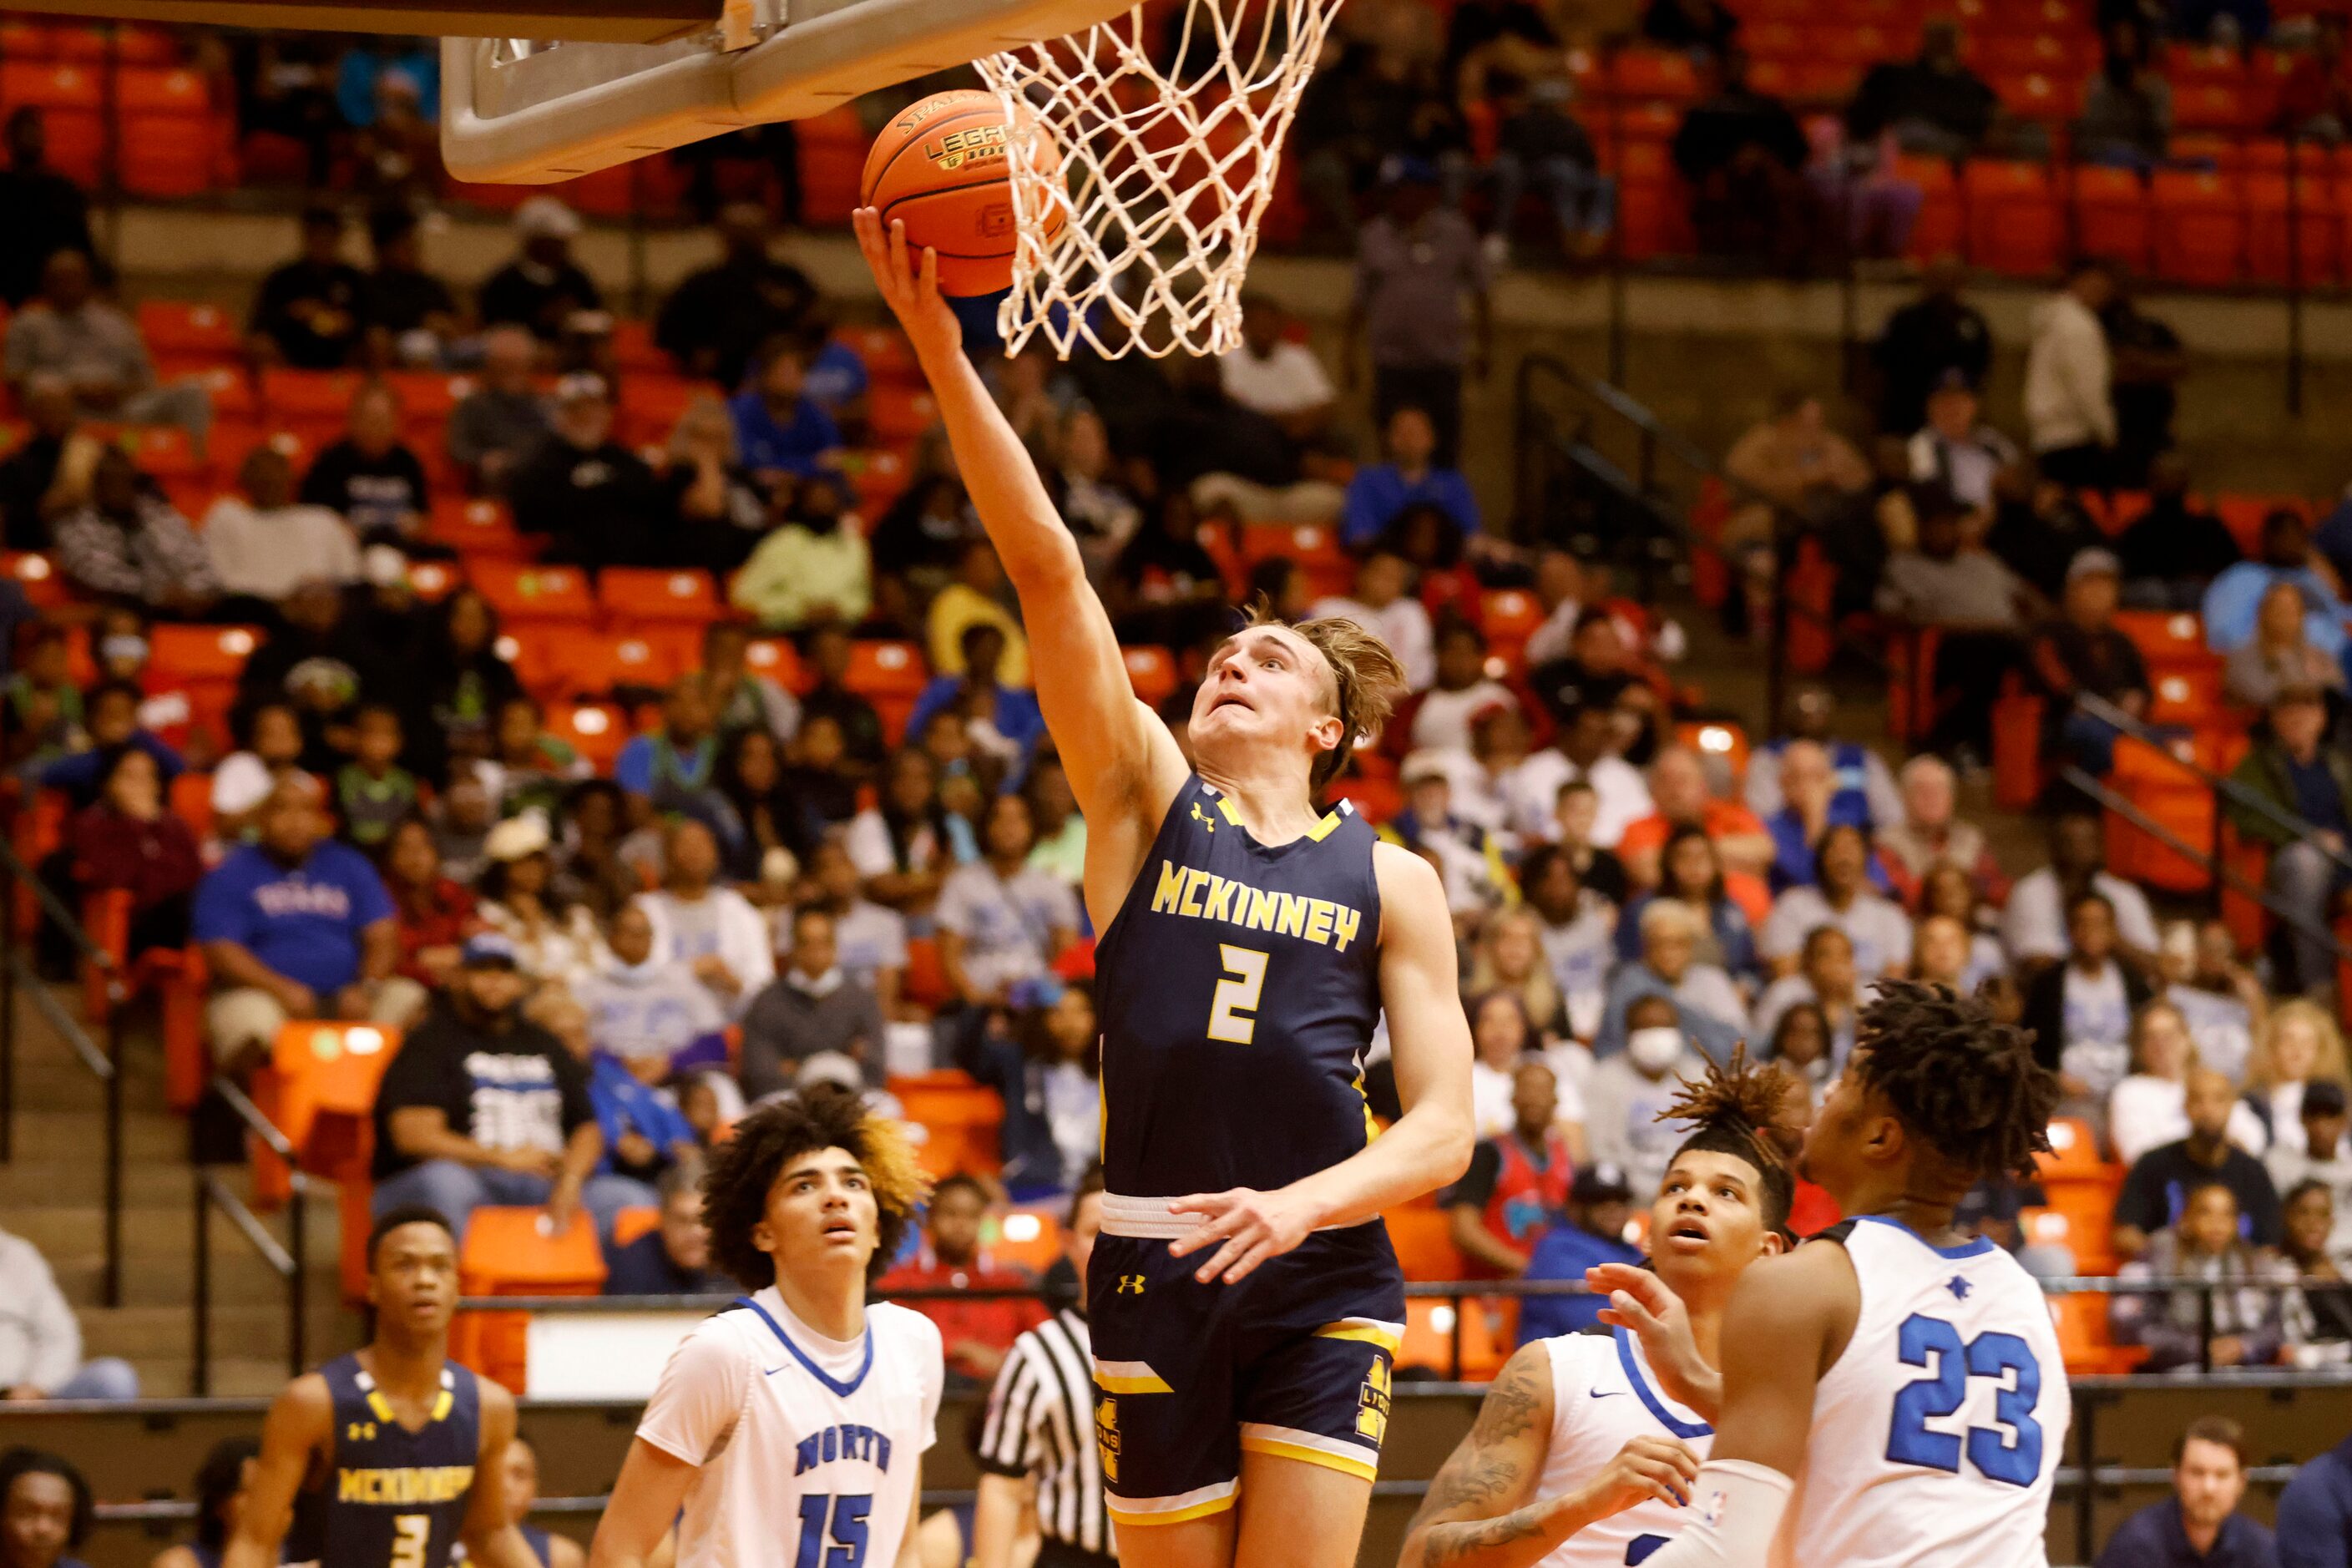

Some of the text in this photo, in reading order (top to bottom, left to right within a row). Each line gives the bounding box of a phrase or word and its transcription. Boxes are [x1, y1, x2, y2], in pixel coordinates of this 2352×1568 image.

[923, 124, 1010, 160] LEGA
[1151, 859, 1362, 953] MCKINNEY
[1206, 943, 1270, 1044] 2
[1884, 1312, 2043, 1489] 23
[794, 1423, 891, 1477] NORTH
[796, 1493, 874, 1568] 15
